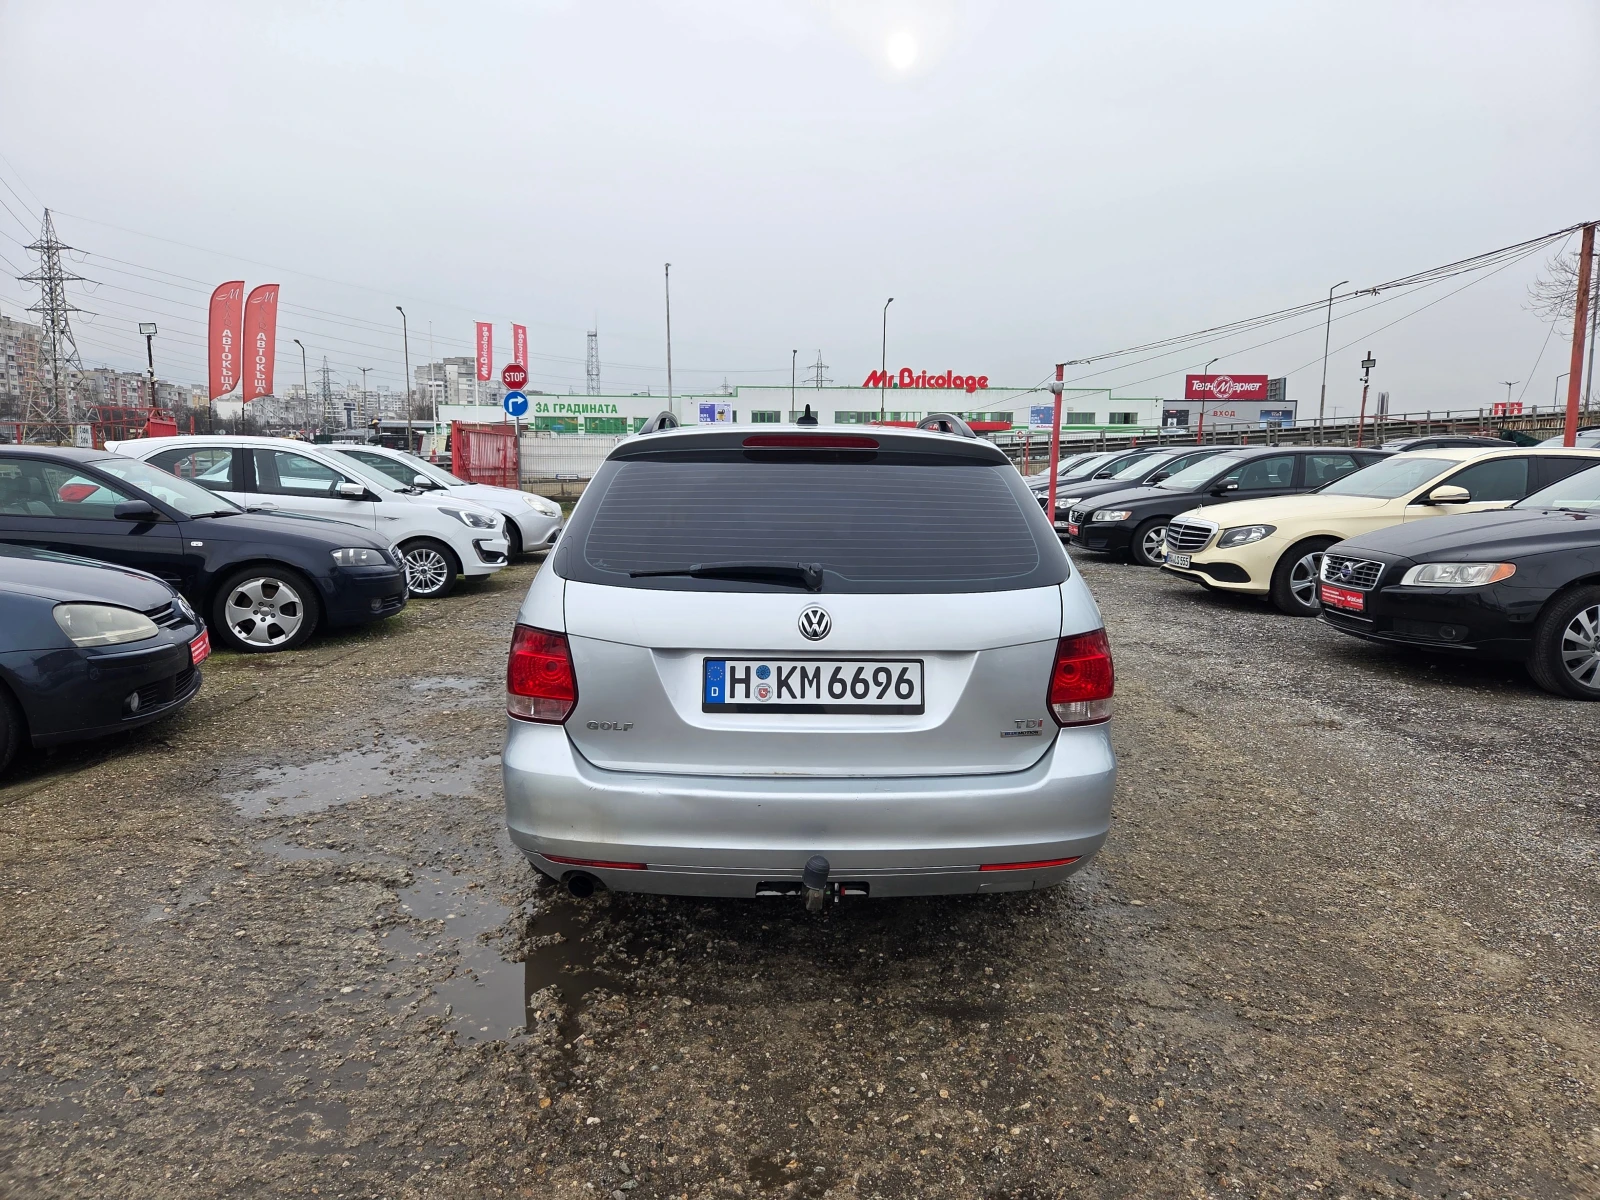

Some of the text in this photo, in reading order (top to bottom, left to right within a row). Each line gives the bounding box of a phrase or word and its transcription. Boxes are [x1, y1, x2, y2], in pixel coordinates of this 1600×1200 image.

[221, 329, 232, 391] АВТОКЪЩА
[255, 332, 266, 394] АВТОКЪЩА
[505, 372, 525, 382] STOP
[535, 403, 618, 415] ЗА ГРАДИНАТА
[711, 665, 915, 700] D H KM 6696
[586, 720, 634, 731] GOLF
[1014, 718, 1043, 729] TDI
